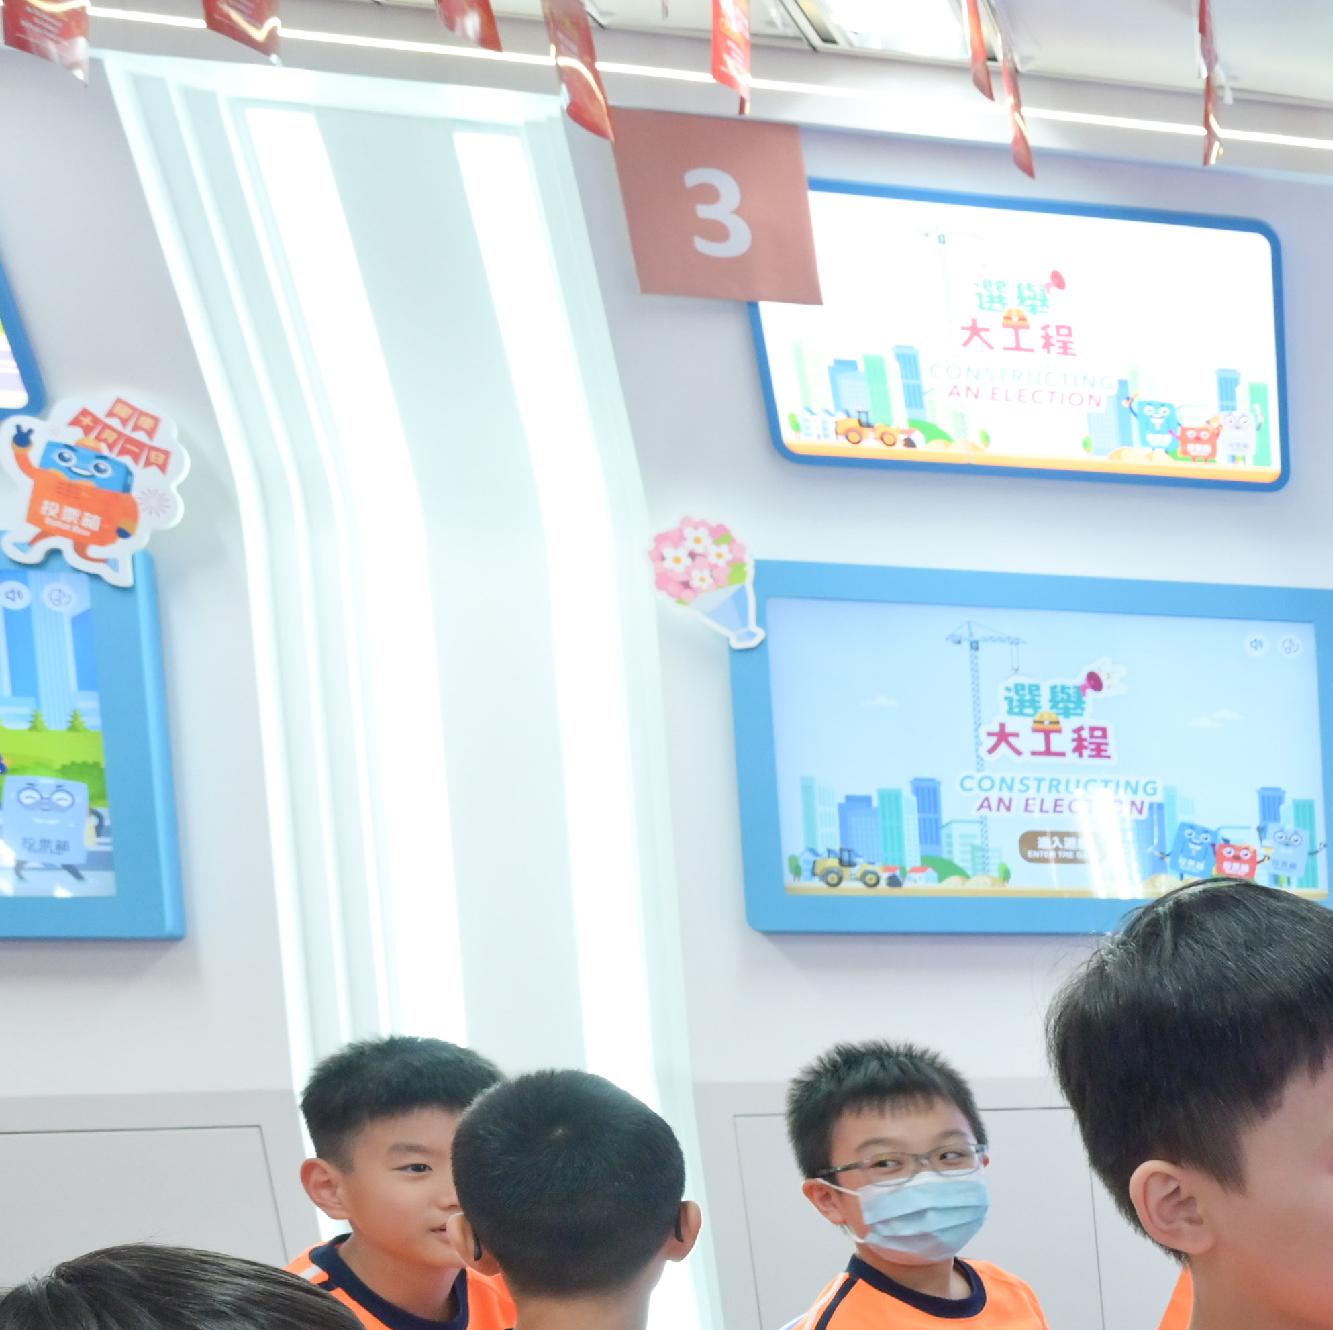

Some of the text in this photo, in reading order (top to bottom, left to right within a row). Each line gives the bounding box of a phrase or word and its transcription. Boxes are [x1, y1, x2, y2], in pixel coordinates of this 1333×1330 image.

[683, 167, 753, 258] 3
[960, 317, 1078, 357] 大工程
[929, 361, 1117, 391] CONSTRUCTING
[948, 385, 1103, 409] AN ELECTION
[1003, 682, 1086, 719] 選舉
[985, 722, 1112, 760] 大工程
[976, 796, 1016, 815] AN
